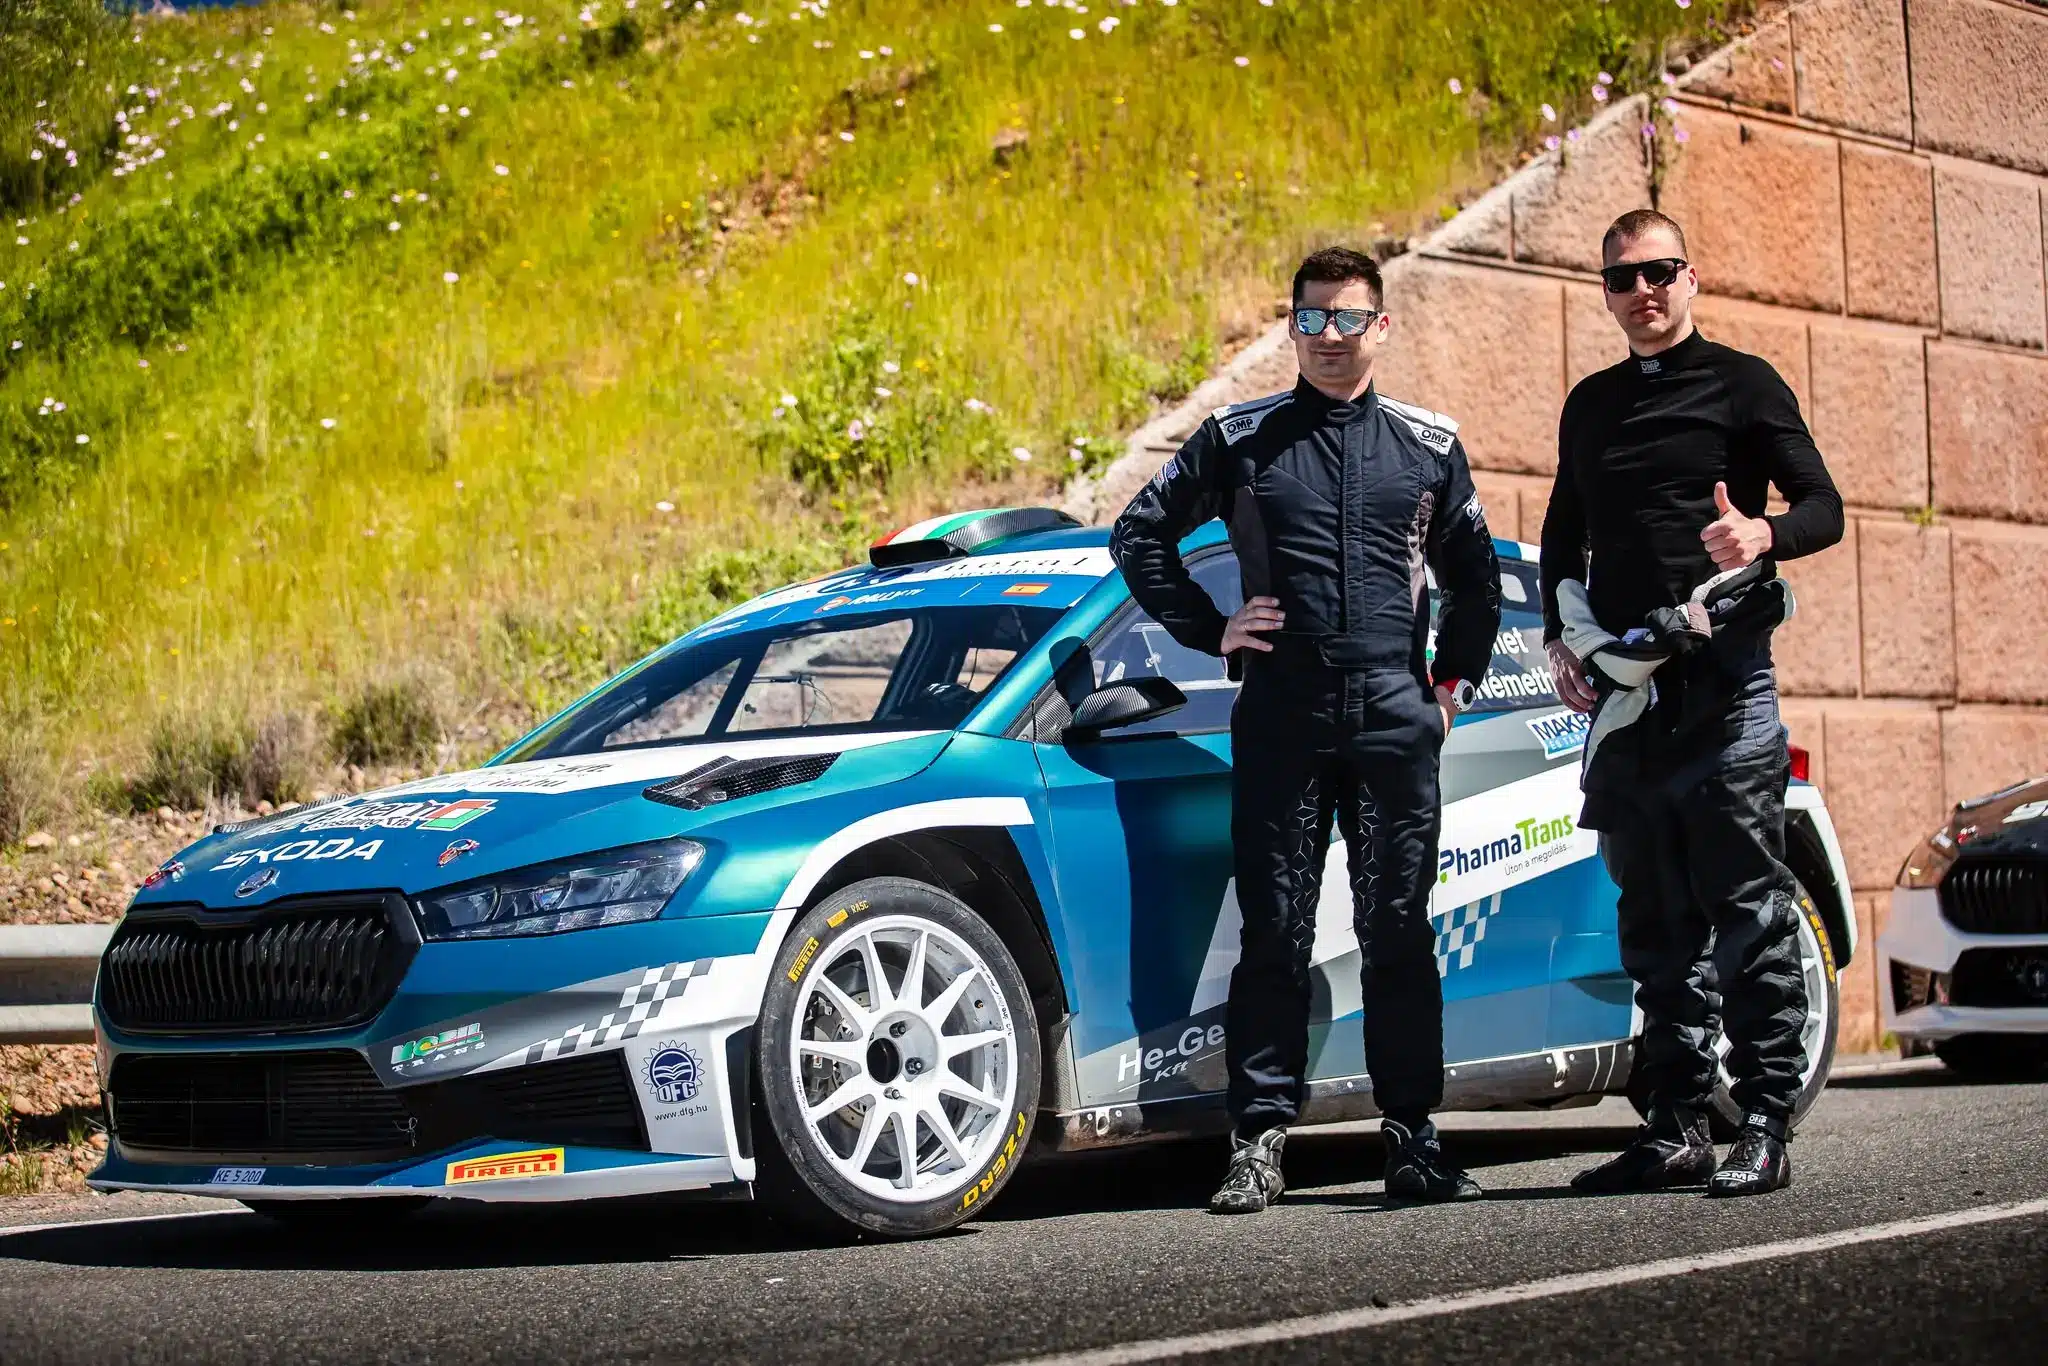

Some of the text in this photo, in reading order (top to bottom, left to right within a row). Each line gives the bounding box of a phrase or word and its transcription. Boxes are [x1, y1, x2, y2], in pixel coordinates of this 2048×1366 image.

[1641, 362, 1660, 371] OMP
[1227, 418, 1254, 433] OMP
[1421, 429, 1449, 444] OMP
[1476, 666, 1557, 700] Németh
[1532, 712, 1592, 741] MAKR
[1439, 814, 1574, 884] PharmaTrans
[787, 935, 820, 982] PIRELLI
[391, 1041, 486, 1073] TRANS
[1154, 1060, 1188, 1082] Kft
[658, 1081, 698, 1102] DFG
[654, 1105, 708, 1121] www.dfg.hu
[215, 1169, 231, 1182] KE
[241, 1169, 262, 1183] 200
[453, 1153, 557, 1180] PIRELLI
